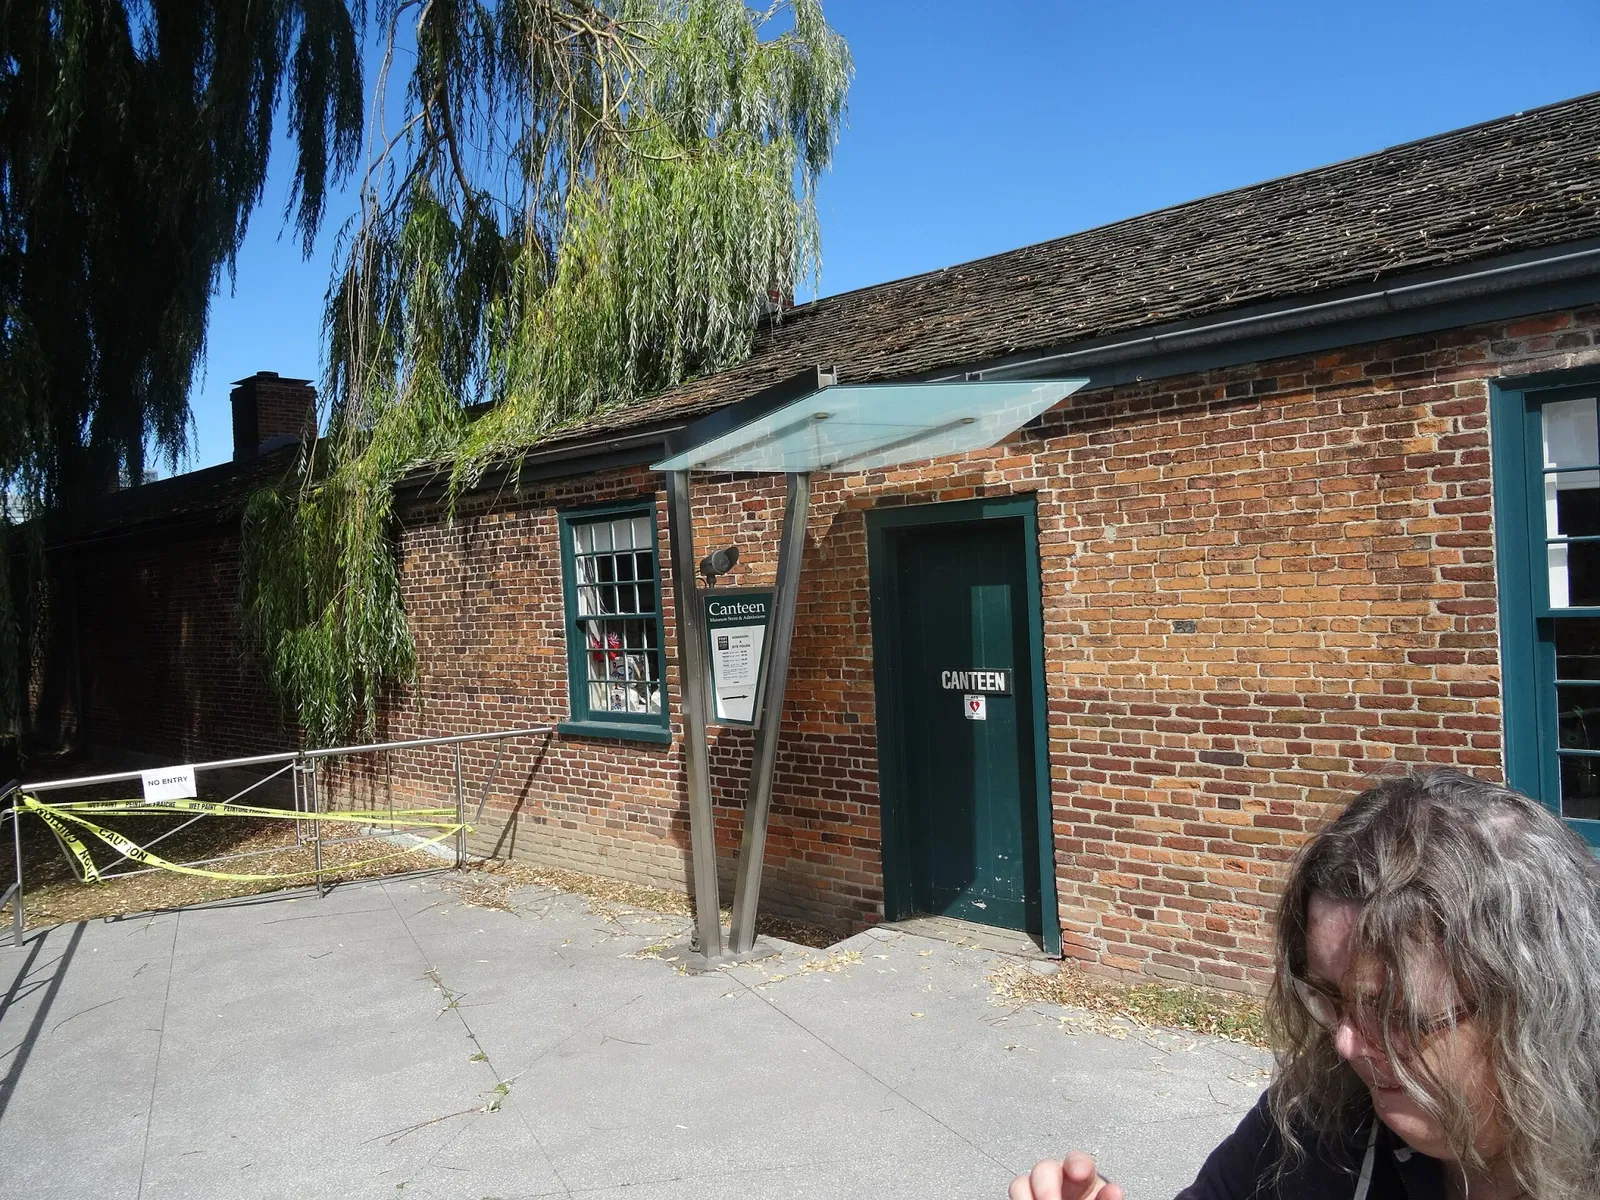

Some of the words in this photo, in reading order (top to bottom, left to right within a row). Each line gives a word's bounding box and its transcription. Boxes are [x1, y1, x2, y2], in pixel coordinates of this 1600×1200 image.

[709, 602, 765, 616] Canteen
[941, 670, 1005, 691] CANTEEN
[162, 776, 188, 785] ENTRY
[202, 803, 217, 811] PAINT
